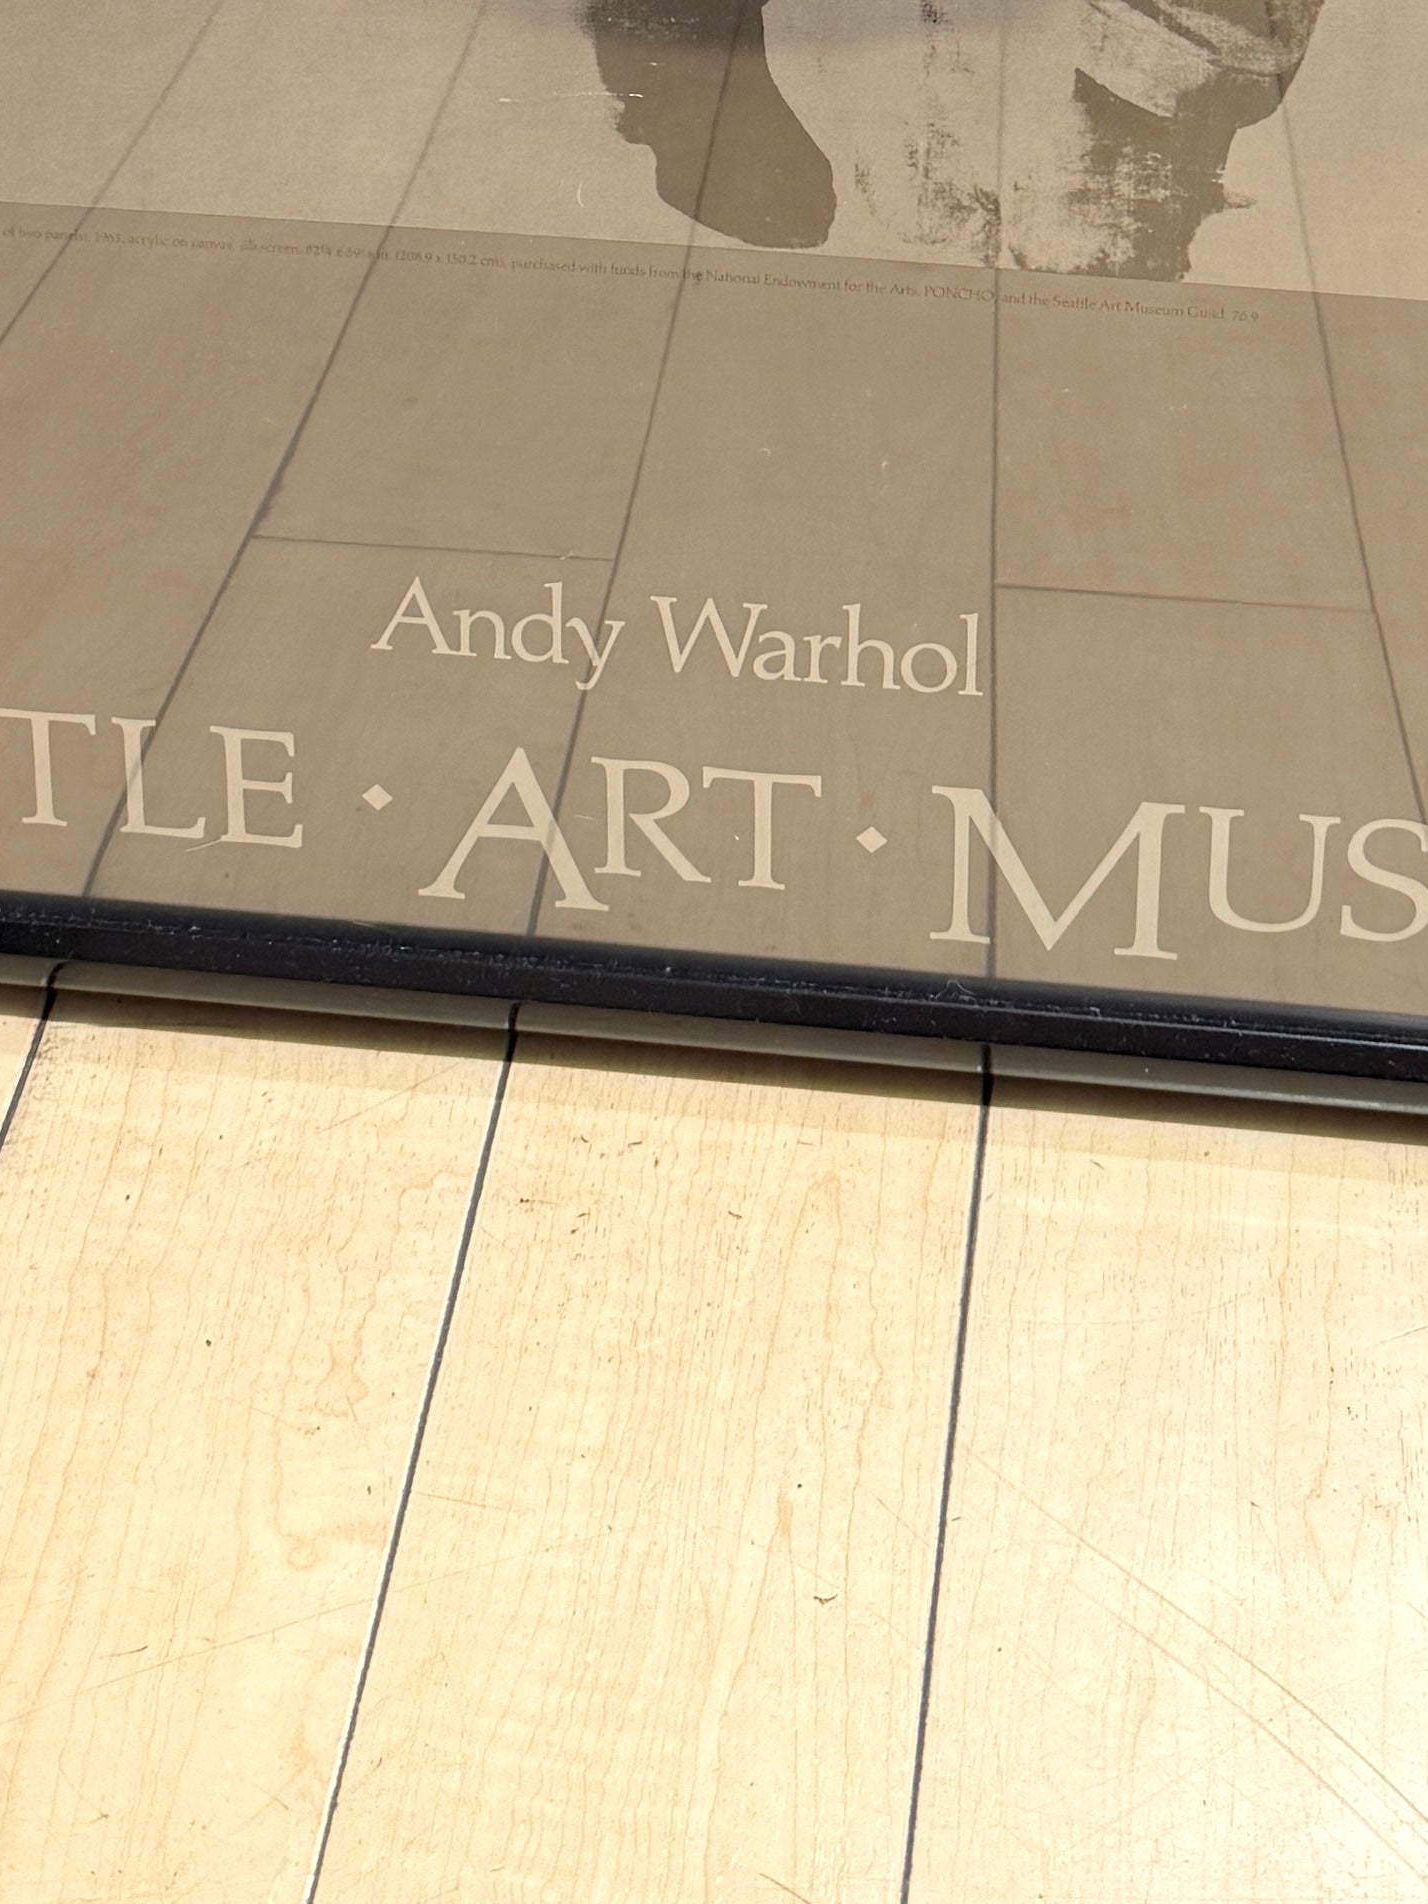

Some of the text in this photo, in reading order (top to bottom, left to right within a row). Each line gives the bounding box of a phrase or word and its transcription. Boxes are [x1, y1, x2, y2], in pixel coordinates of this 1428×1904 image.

[705, 270, 760, 286] National
[763, 274, 841, 292] Endowment
[843, 280, 862, 293] for
[1001, 291, 1026, 305] and
[1027, 293, 1049, 307] the
[1052, 295, 1096, 310] Seattle
[1100, 298, 1122, 312] Art
[1124, 300, 1183, 317] Museum
[372, 574, 984, 697] Andy Warhol
[417, 746, 823, 912] ART
